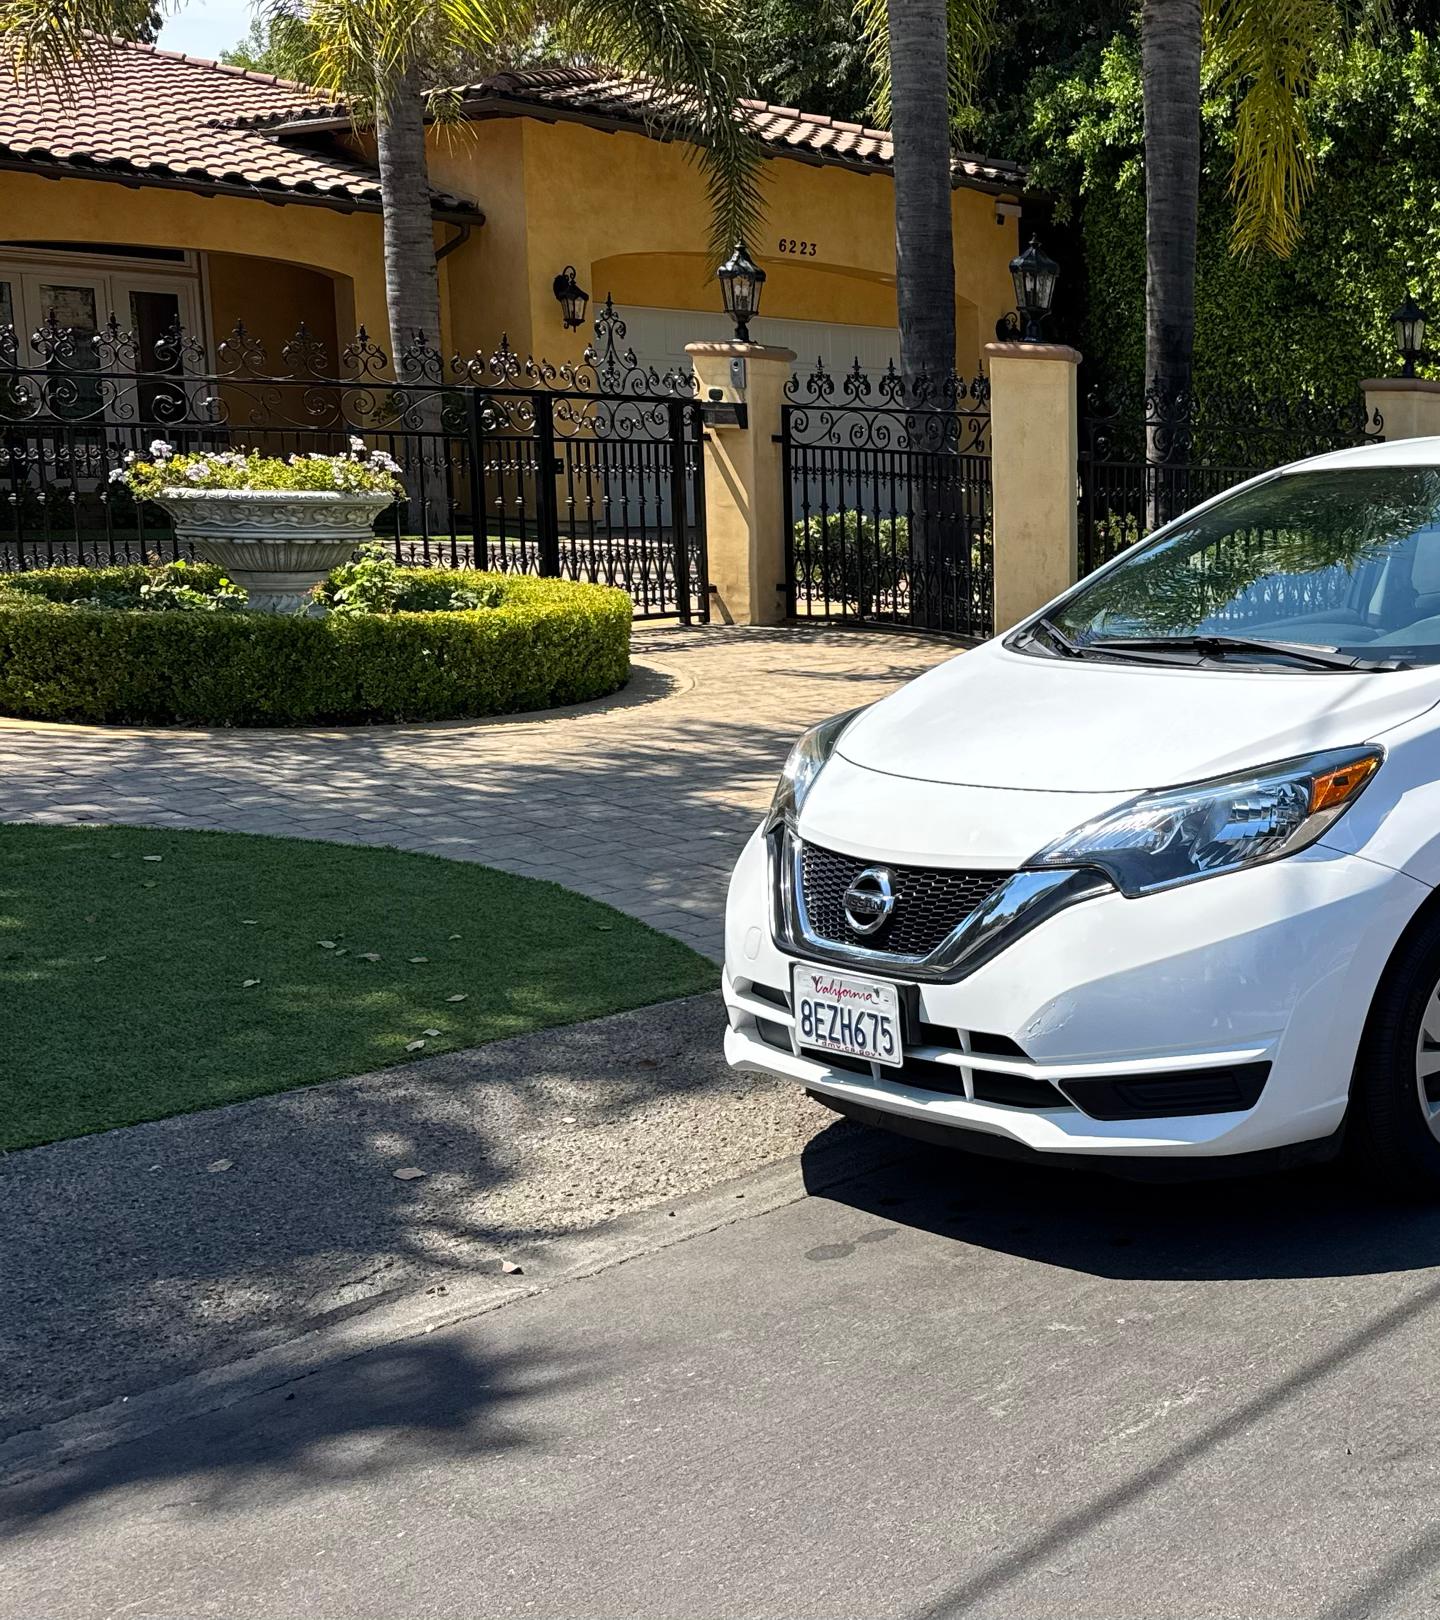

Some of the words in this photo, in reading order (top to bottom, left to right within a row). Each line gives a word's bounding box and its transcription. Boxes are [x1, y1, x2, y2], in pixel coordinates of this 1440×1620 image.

[779, 239, 817, 256] 6223
[812, 976, 879, 1005] California
[801, 999, 895, 1056] 8EZH675
[822, 1041, 876, 1056] dmv.ca.gov
